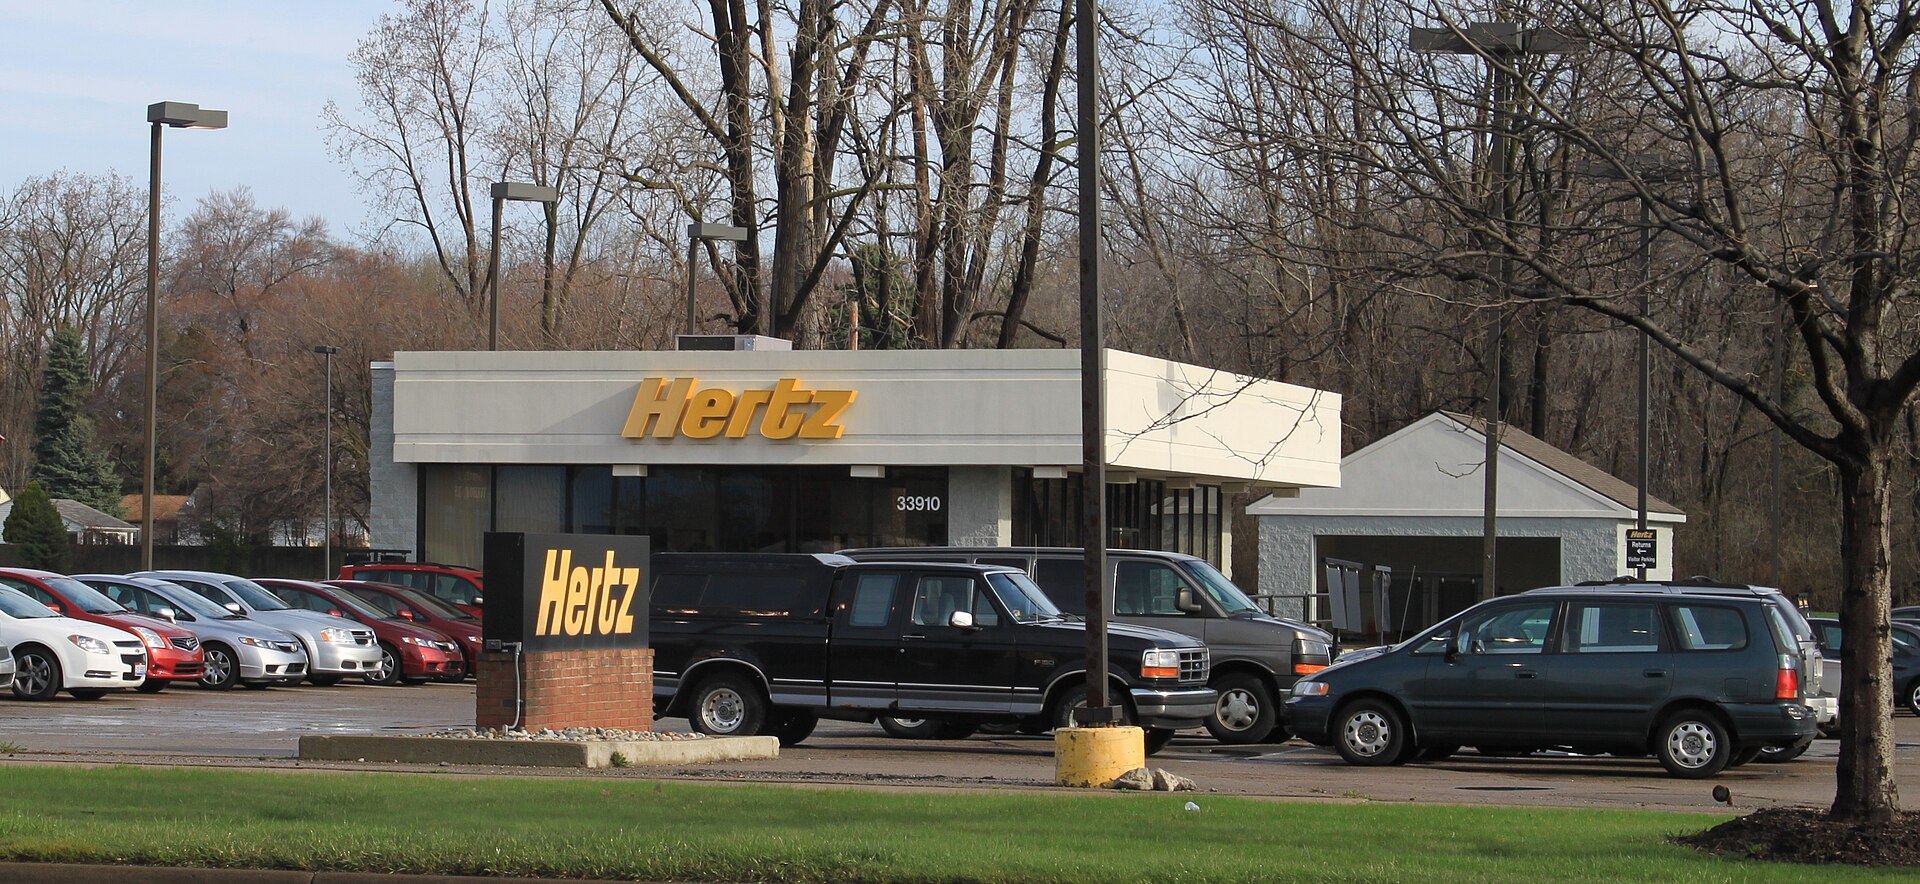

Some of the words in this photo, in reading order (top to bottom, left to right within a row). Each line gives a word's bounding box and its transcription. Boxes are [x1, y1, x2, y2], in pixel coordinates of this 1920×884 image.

[621, 377, 857, 439] Hertz
[896, 496, 941, 511] 33910
[1631, 531, 1654, 539] Hertz
[1641, 556, 1656, 564] Parking
[536, 549, 640, 636] Hertz
